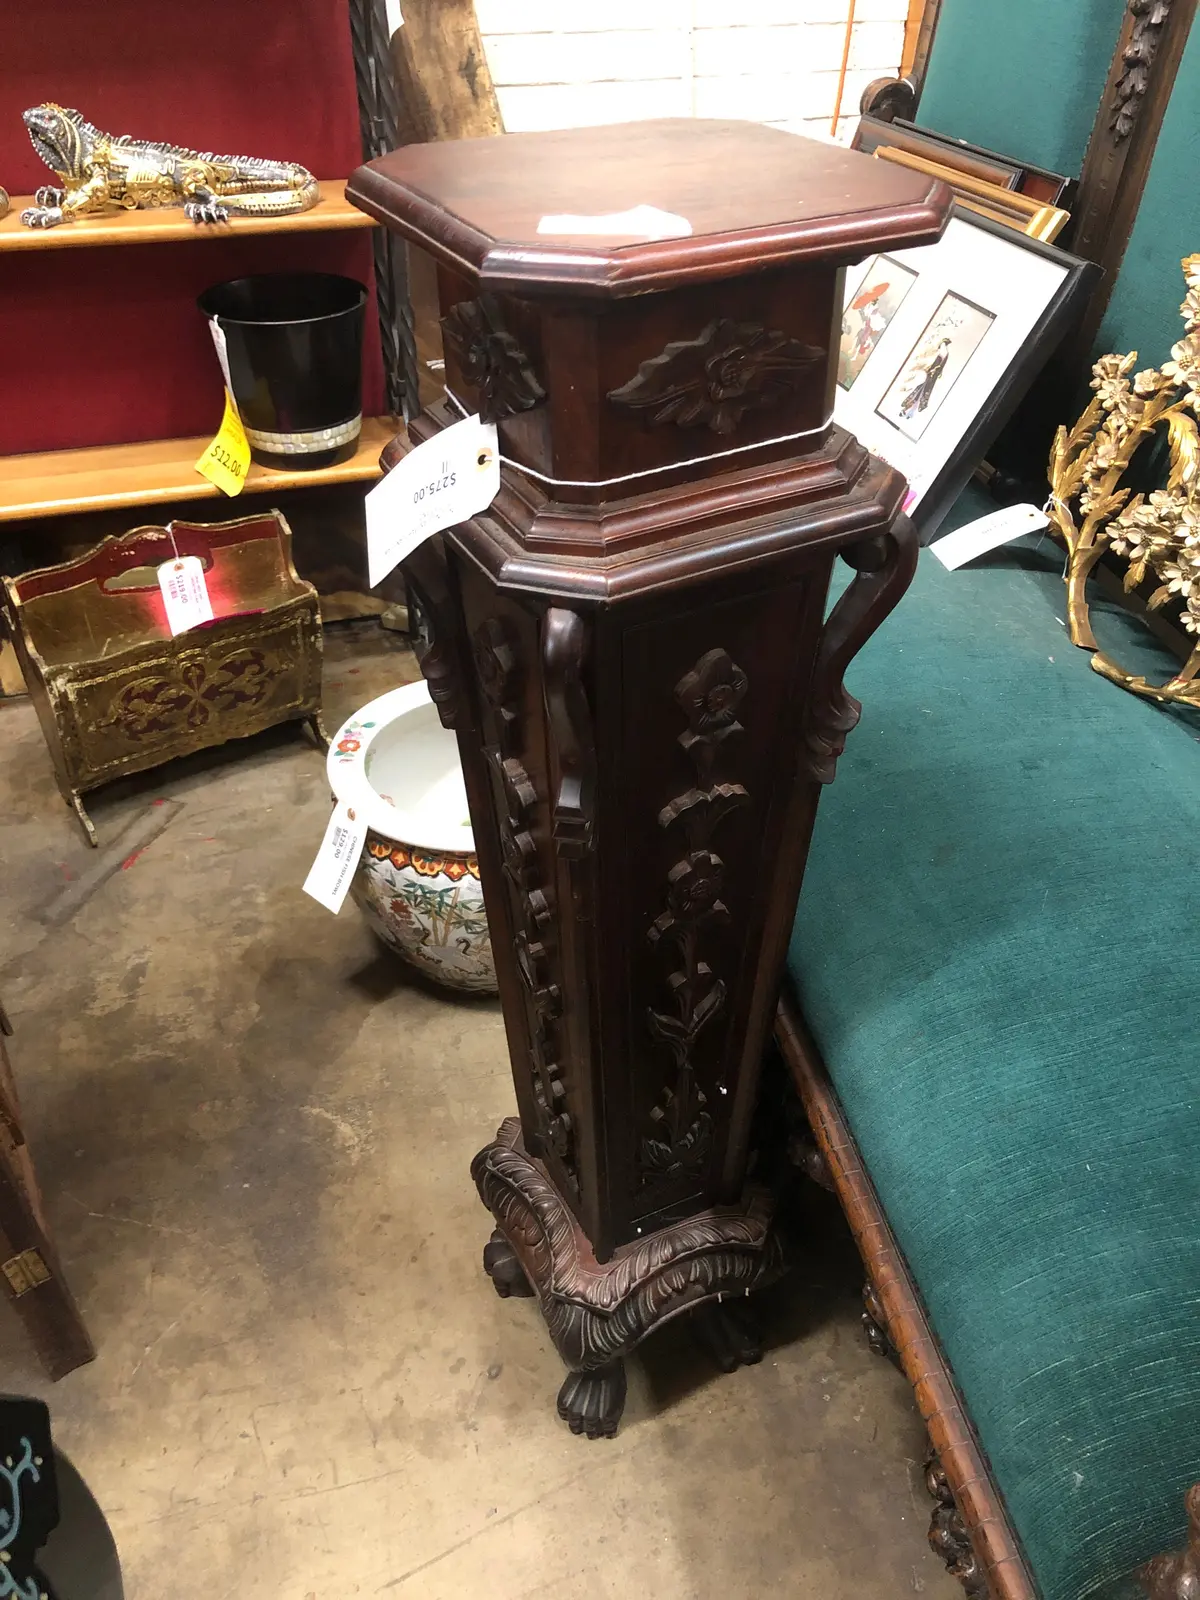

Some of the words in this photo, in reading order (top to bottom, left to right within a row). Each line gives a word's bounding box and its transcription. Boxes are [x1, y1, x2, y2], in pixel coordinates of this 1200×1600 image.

[210, 445, 241, 477] $12.00
[413, 472, 457, 504] $275.00
[334, 828, 349, 859] $129.00
[346, 835, 358, 862] CHINESE
[339, 863, 349, 878] FISH
[332, 877, 342, 896] BOWL
